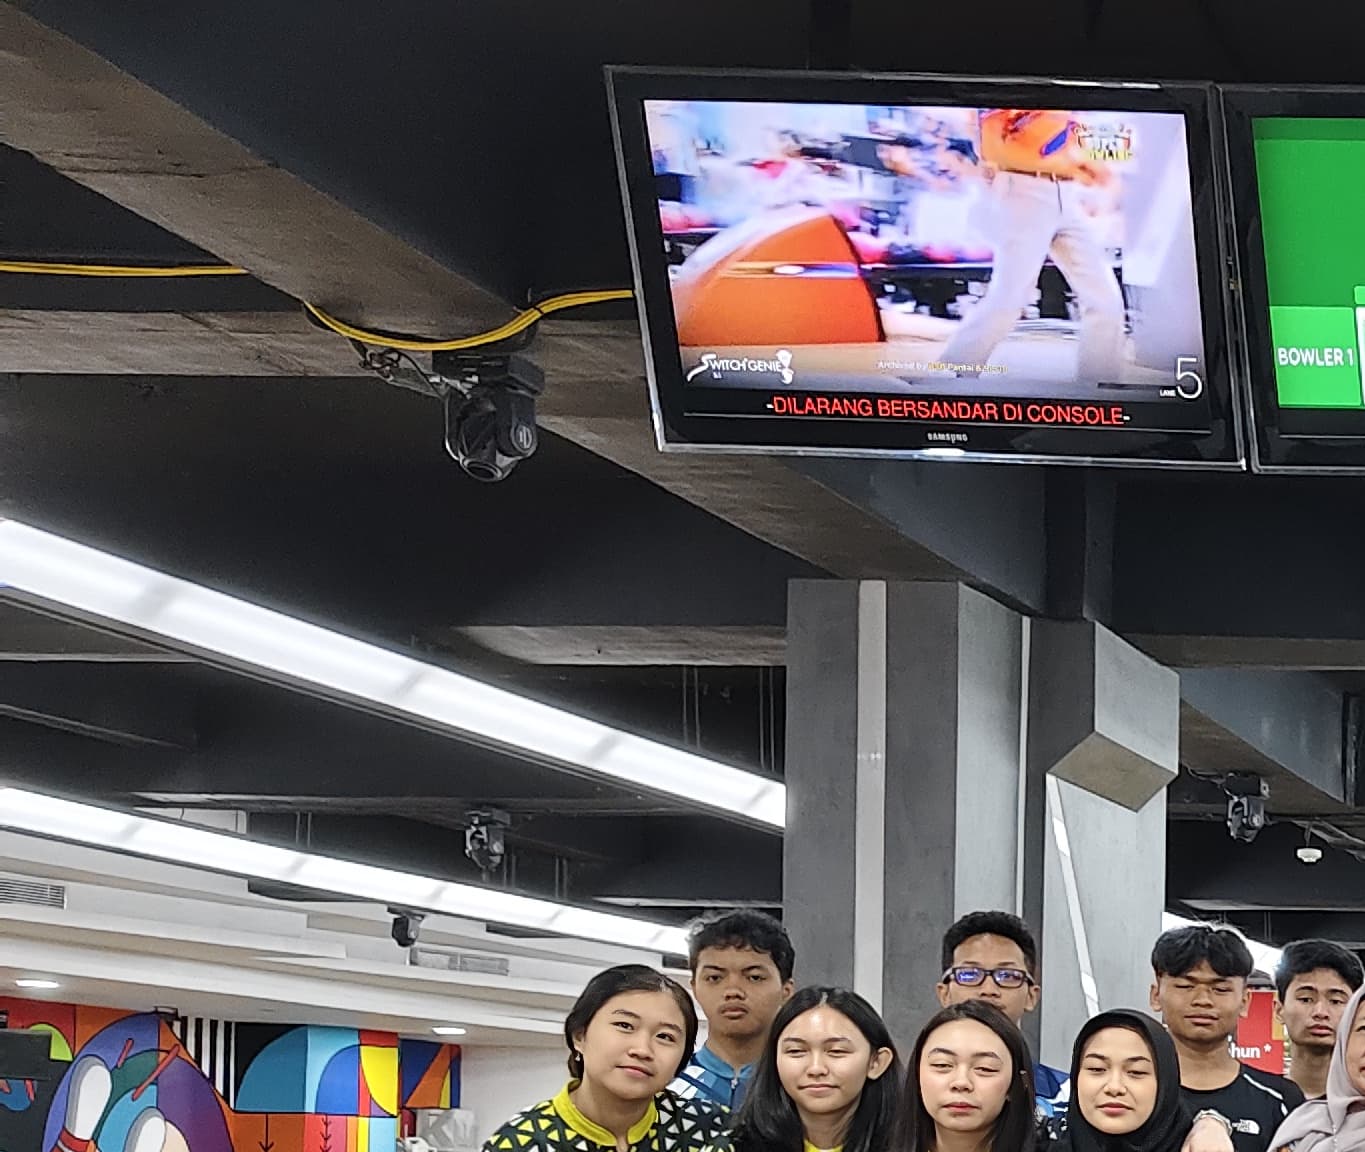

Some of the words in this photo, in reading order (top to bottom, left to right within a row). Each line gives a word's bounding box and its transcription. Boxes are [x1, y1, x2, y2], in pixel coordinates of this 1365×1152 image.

[1278, 347, 1345, 368] BOWLER
[1346, 347, 1354, 368] 1
[1176, 357, 1202, 398] 5
[877, 399, 999, 421] BERSANDAR
[1004, 403, 1023, 422] DI
[927, 433, 968, 443] SAMSUNG
